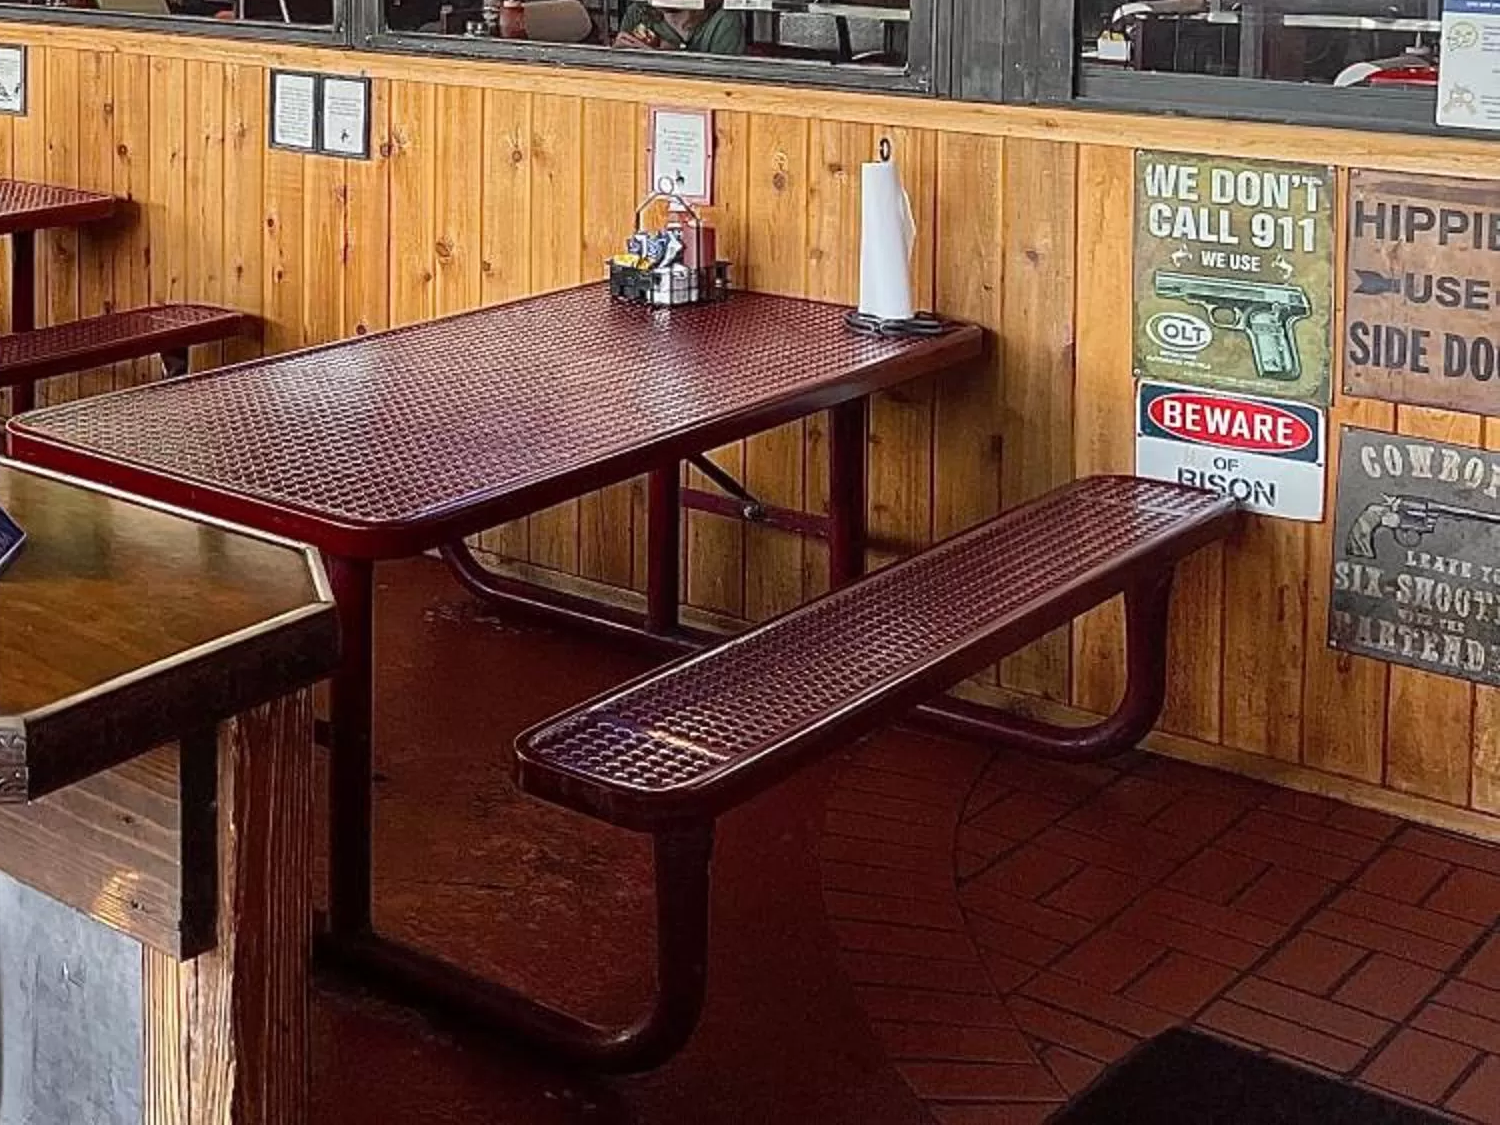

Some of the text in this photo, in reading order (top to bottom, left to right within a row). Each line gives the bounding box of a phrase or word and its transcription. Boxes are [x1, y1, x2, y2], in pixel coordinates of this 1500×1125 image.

[1145, 163, 1323, 212] WE DON'T
[1149, 202, 1316, 252] CALL 911
[1201, 250, 1261, 272] WE USE
[1405, 272, 1490, 311] USE
[1349, 321, 1500, 382] SIDE DO
[1162, 399, 1294, 446] BEWARE
[1213, 456, 1240, 472] OF
[1406, 550, 1472, 579] LEAVE
[1335, 561, 1500, 623] SIX-SHOOT
[1331, 610, 1500, 673] BARTEND
